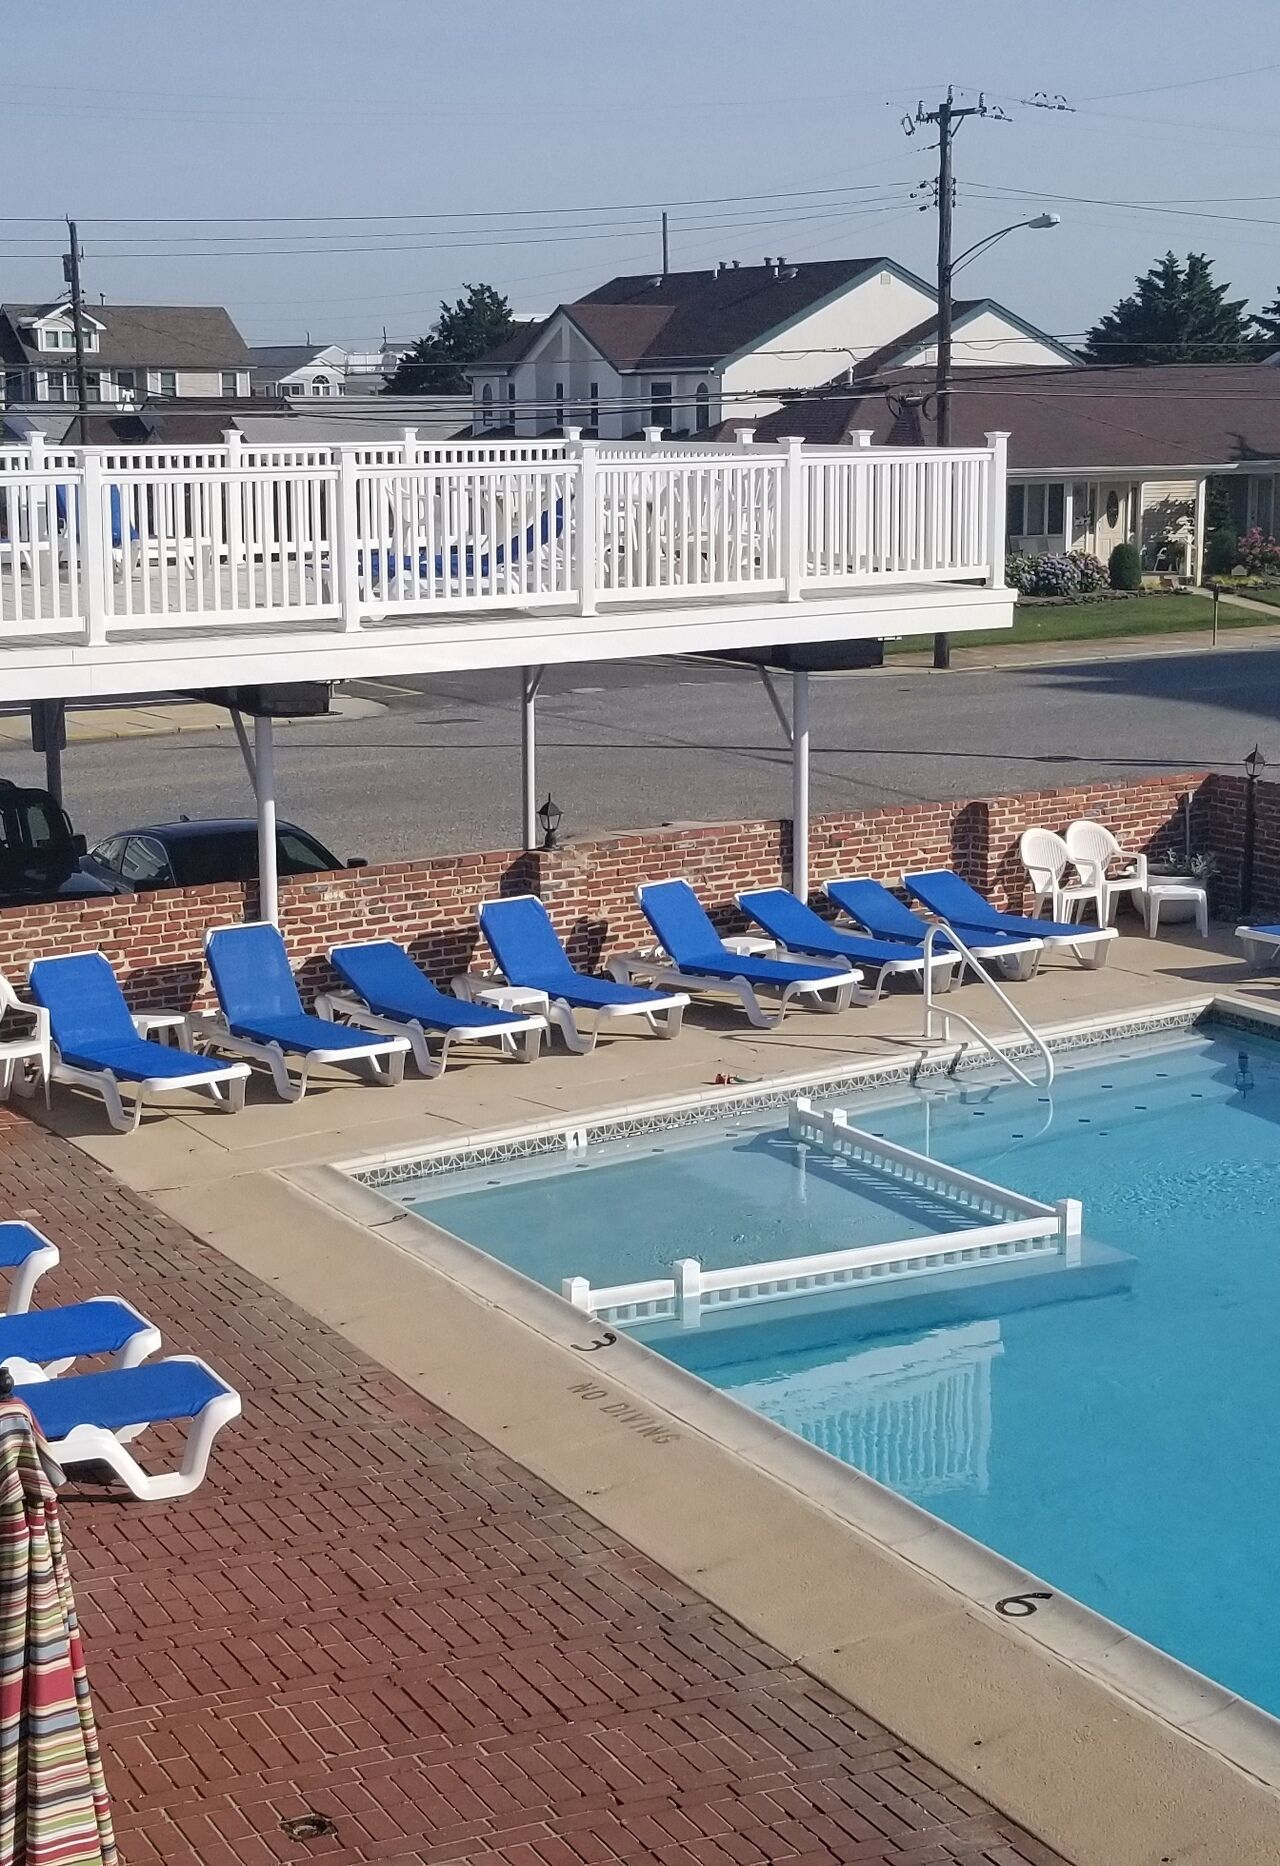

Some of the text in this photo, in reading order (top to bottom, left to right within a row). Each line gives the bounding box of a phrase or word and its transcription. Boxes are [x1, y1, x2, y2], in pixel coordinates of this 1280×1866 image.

[572, 1131, 580, 1147] 1
[570, 1332, 617, 1352] 3
[566, 1382, 682, 1445] NO DIVING
[994, 1592, 1053, 1617] 6
